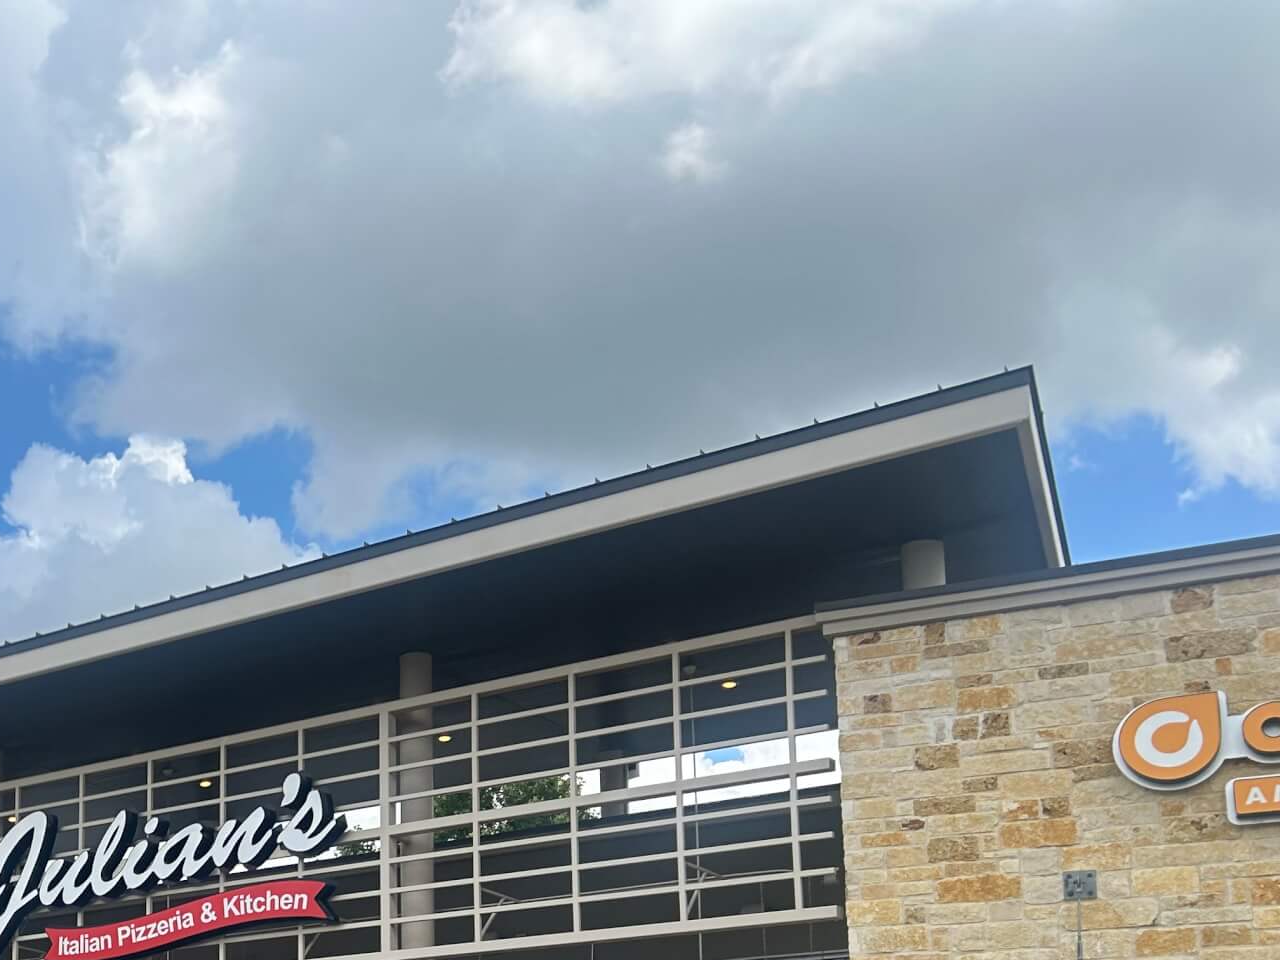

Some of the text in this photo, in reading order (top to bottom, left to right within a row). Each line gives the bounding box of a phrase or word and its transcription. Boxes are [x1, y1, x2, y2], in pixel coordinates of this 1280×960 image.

[58, 889, 309, 956] Italian Pizzeria & Kitchen
